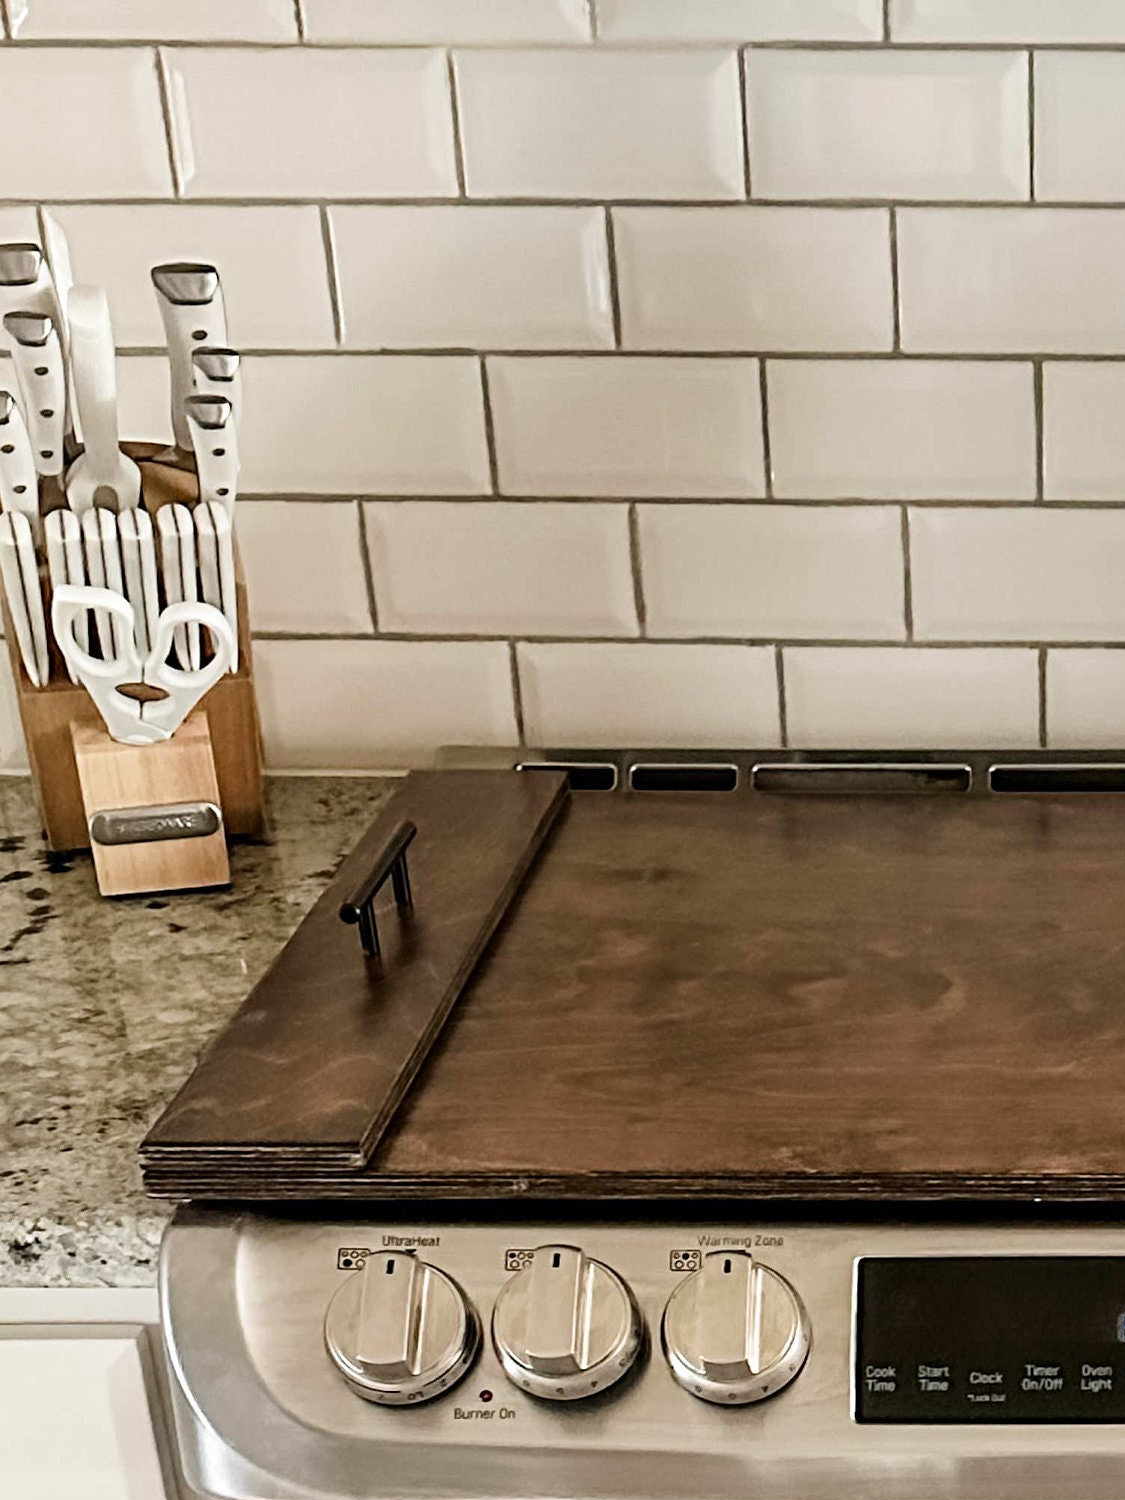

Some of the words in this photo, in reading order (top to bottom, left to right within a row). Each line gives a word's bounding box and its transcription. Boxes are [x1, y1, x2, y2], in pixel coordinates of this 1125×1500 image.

[755, 1234, 784, 1247] Zone
[865, 1365, 896, 1378] Cook
[918, 1365, 950, 1378] Start
[1024, 1364, 1061, 1377] Timer
[1081, 1364, 1113, 1377] Oven
[969, 1372, 1003, 1384] Clock
[1021, 1378, 1064, 1391] On/Off
[865, 1379, 896, 1392] Time
[918, 1379, 949, 1392] Time
[1080, 1378, 1113, 1393] Light
[454, 1407, 496, 1420] Burner
[499, 1407, 516, 1420] On
